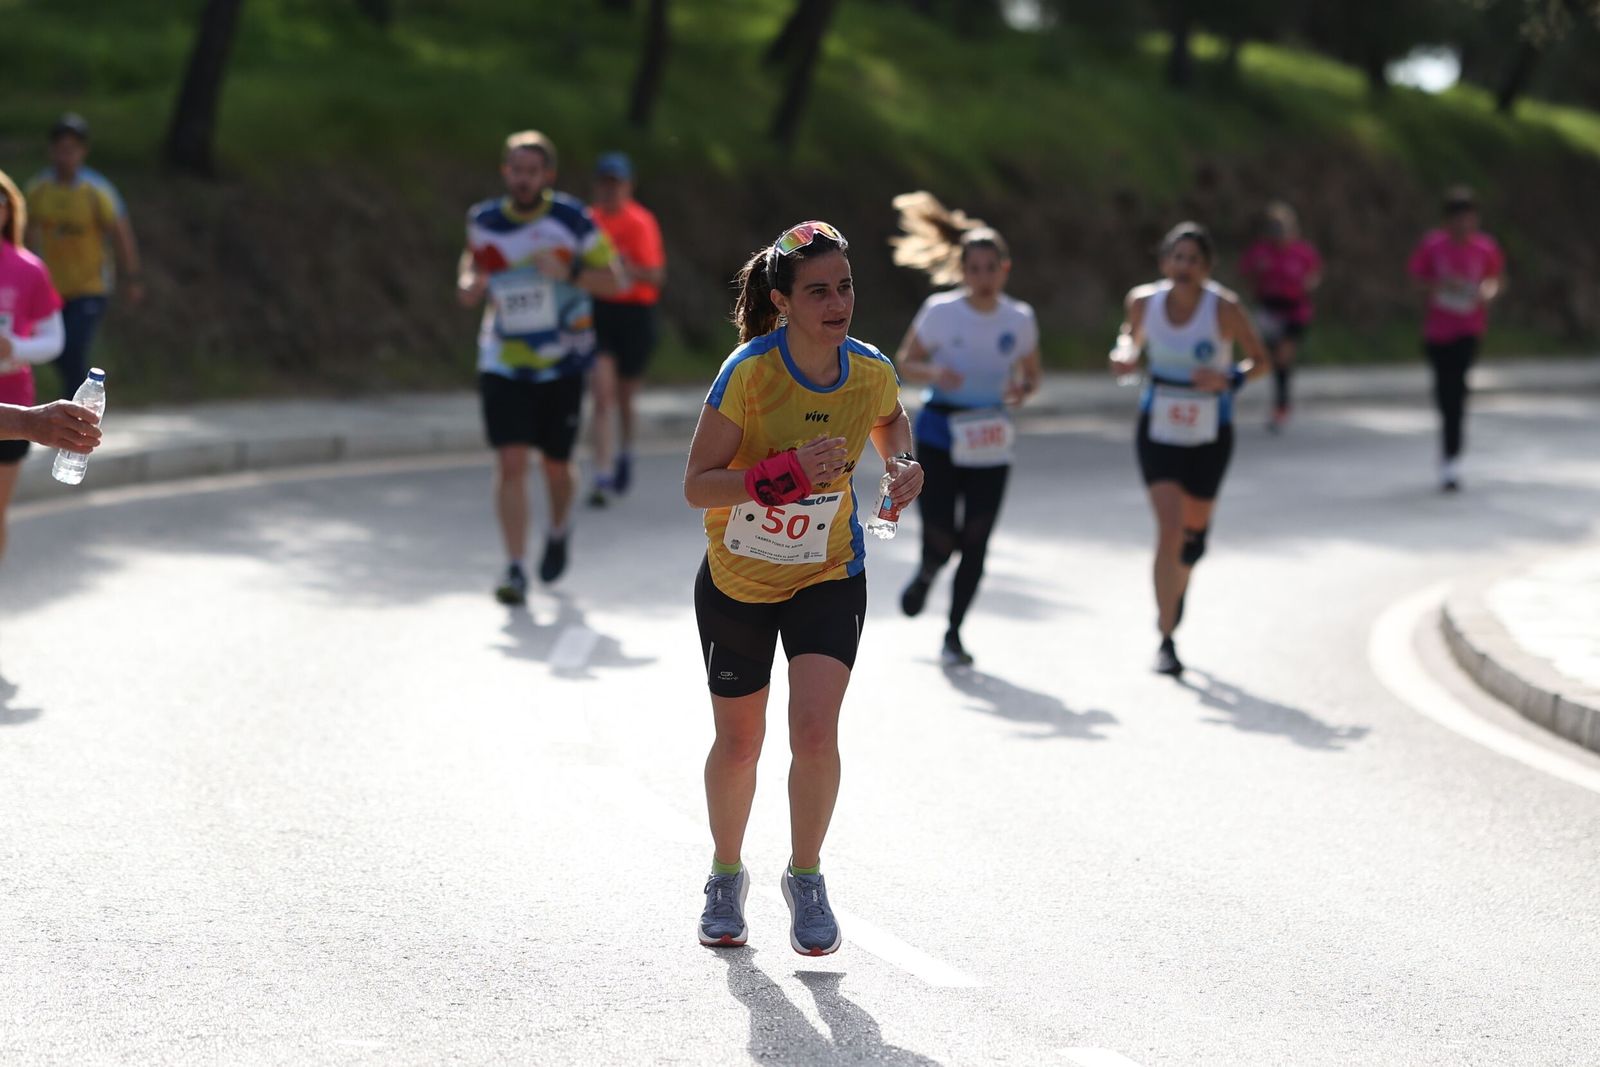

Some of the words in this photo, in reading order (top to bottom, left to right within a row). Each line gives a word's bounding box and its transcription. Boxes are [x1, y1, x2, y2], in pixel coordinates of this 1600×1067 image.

[805, 411, 830, 422] vive
[1169, 403, 1199, 427] 62
[761, 506, 810, 540] 50
